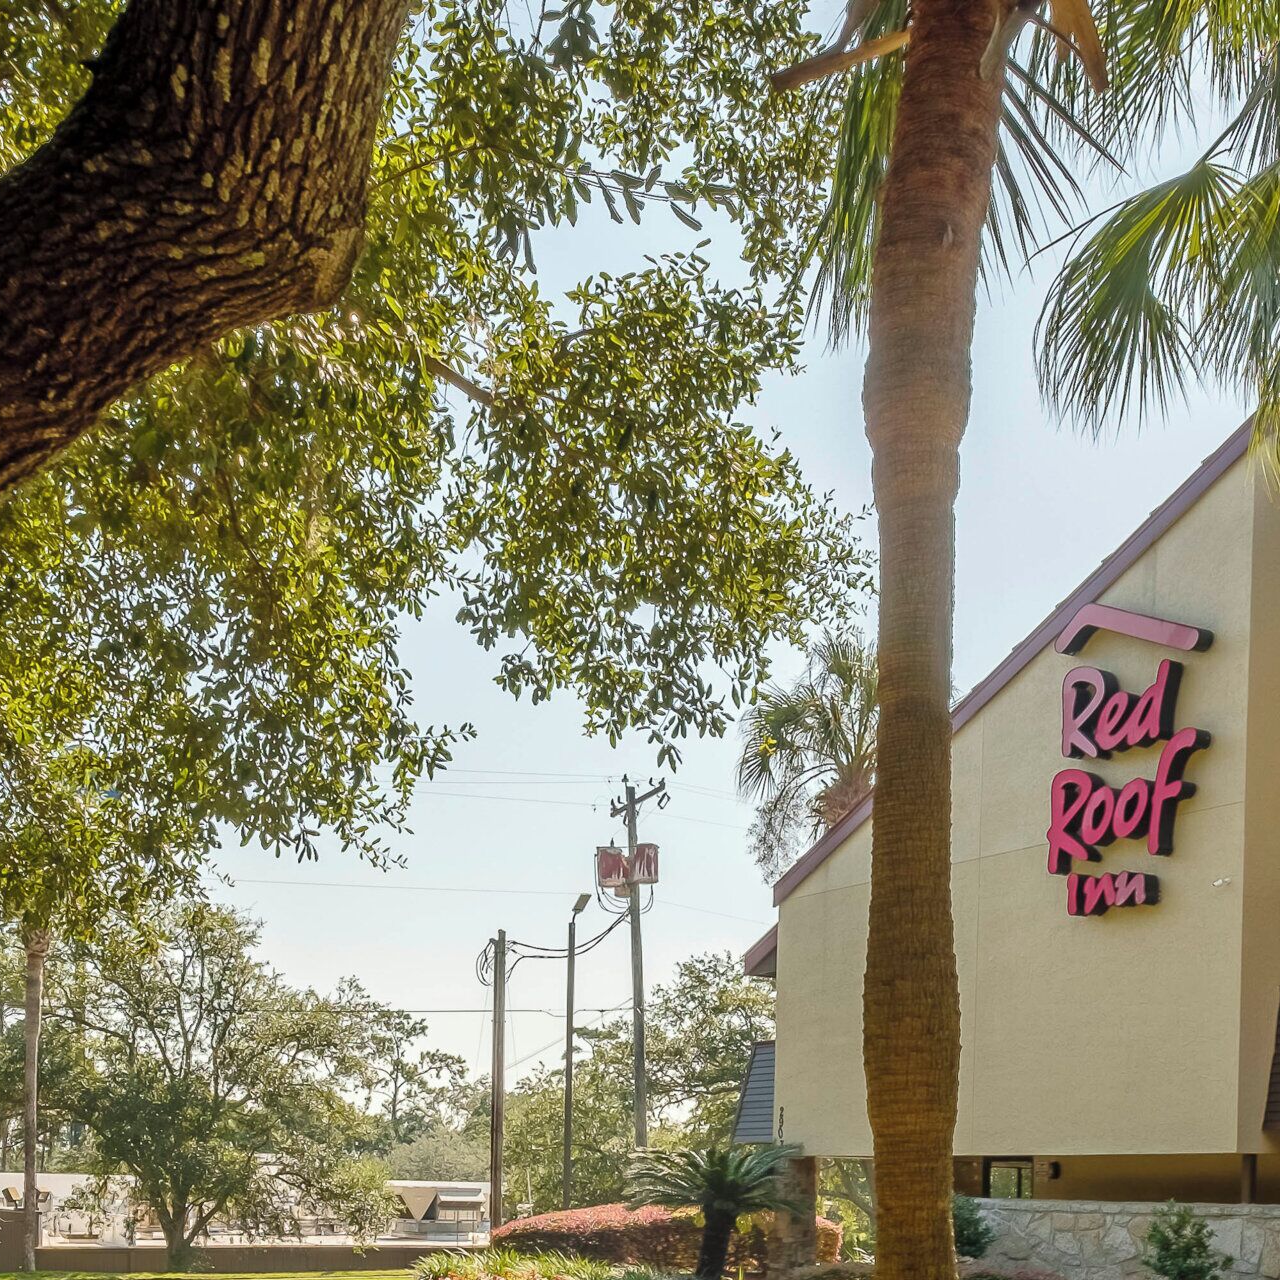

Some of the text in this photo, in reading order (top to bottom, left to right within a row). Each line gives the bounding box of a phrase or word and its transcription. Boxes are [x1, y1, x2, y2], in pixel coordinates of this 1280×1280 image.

[1062, 659, 1176, 758] Red
[1047, 727, 1204, 875] Roof
[1067, 872, 1152, 915] Inn
